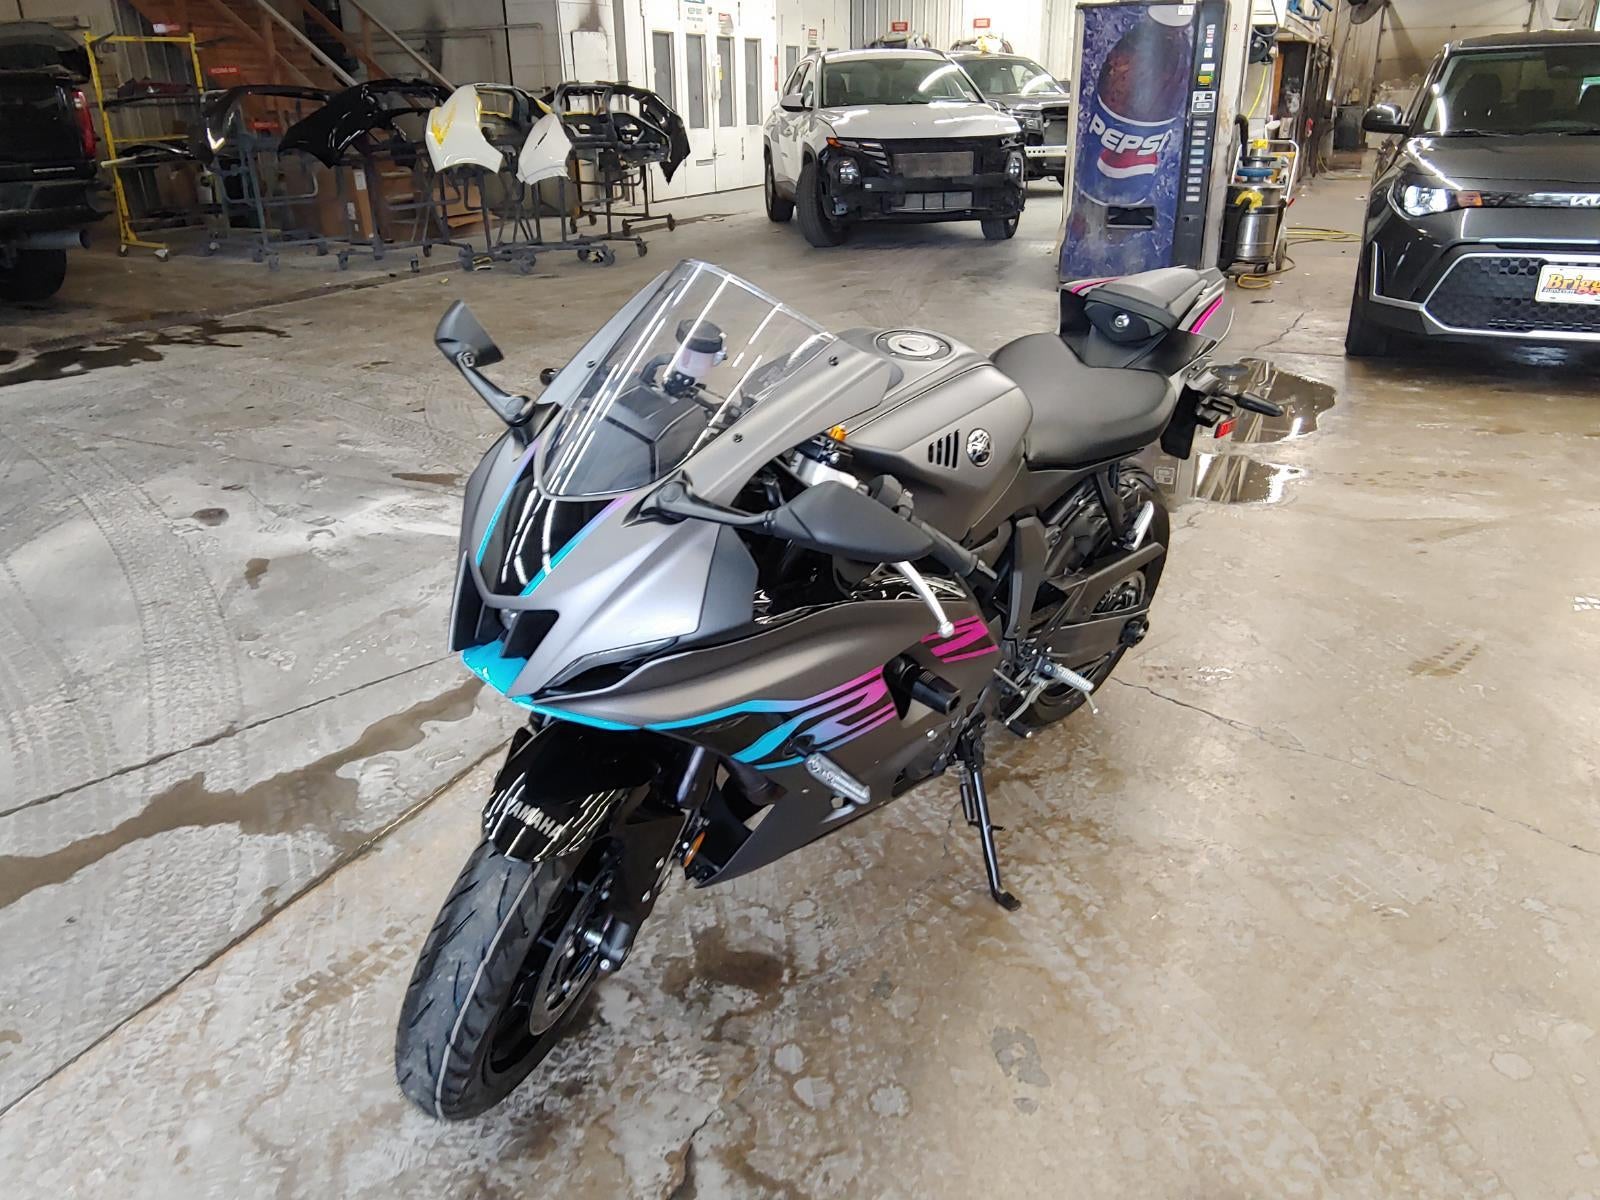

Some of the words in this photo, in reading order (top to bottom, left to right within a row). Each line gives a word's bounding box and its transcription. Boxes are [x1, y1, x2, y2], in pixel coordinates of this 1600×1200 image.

[1089, 113, 1172, 155] PEPSI
[1570, 193, 1600, 207] KI
[503, 797, 565, 842] YAMAHA
